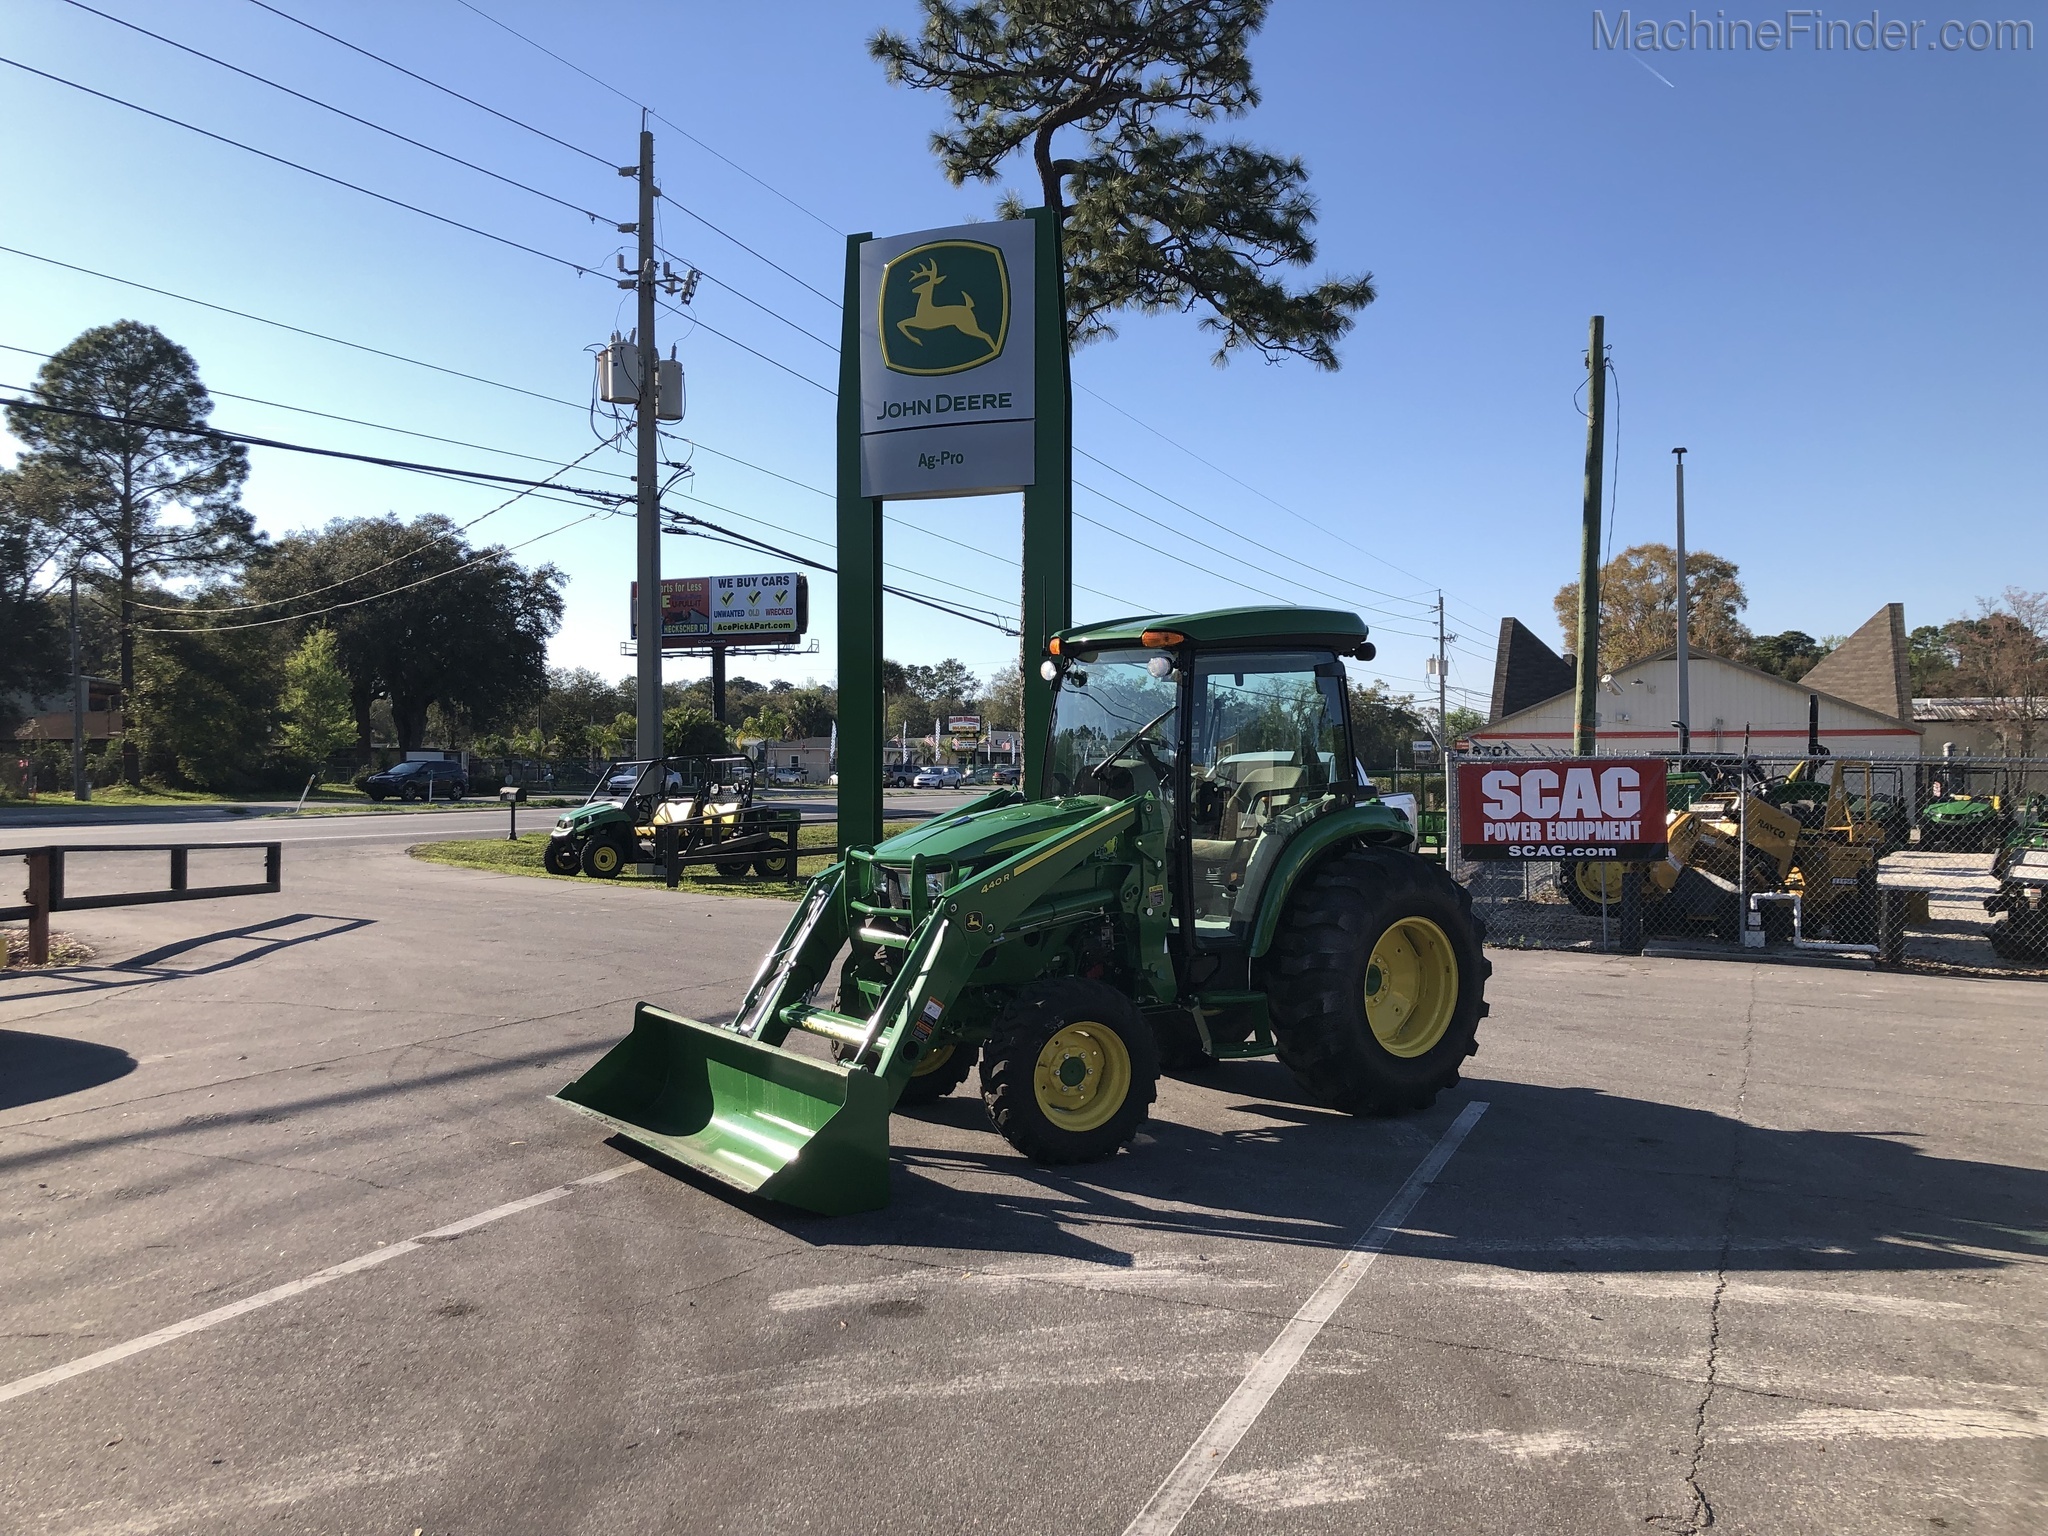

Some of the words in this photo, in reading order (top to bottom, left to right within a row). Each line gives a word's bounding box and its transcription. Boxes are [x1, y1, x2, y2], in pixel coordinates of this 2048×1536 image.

[877, 398, 931, 420] JOHN
[936, 392, 1012, 413] DEERE
[918, 451, 964, 469] Ag-Pro
[661, 583, 673, 593] arts
[675, 582, 685, 592] for
[687, 582, 702, 592] Less
[718, 578, 733, 588] WE
[737, 577, 758, 588] BUY
[762, 575, 790, 587] CARS
[714, 609, 745, 618] UNWANTED
[748, 608, 760, 617] OLD
[765, 608, 794, 616] WRECKED
[717, 622, 791, 631] AcePickAPart.com
[1481, 766, 1641, 820] SCAG
[1483, 821, 1542, 841] POWER
[1546, 820, 1642, 841] EQUIPMENT
[1757, 819, 1786, 839] RAYCO
[1508, 845, 1617, 857] SCAG.com
